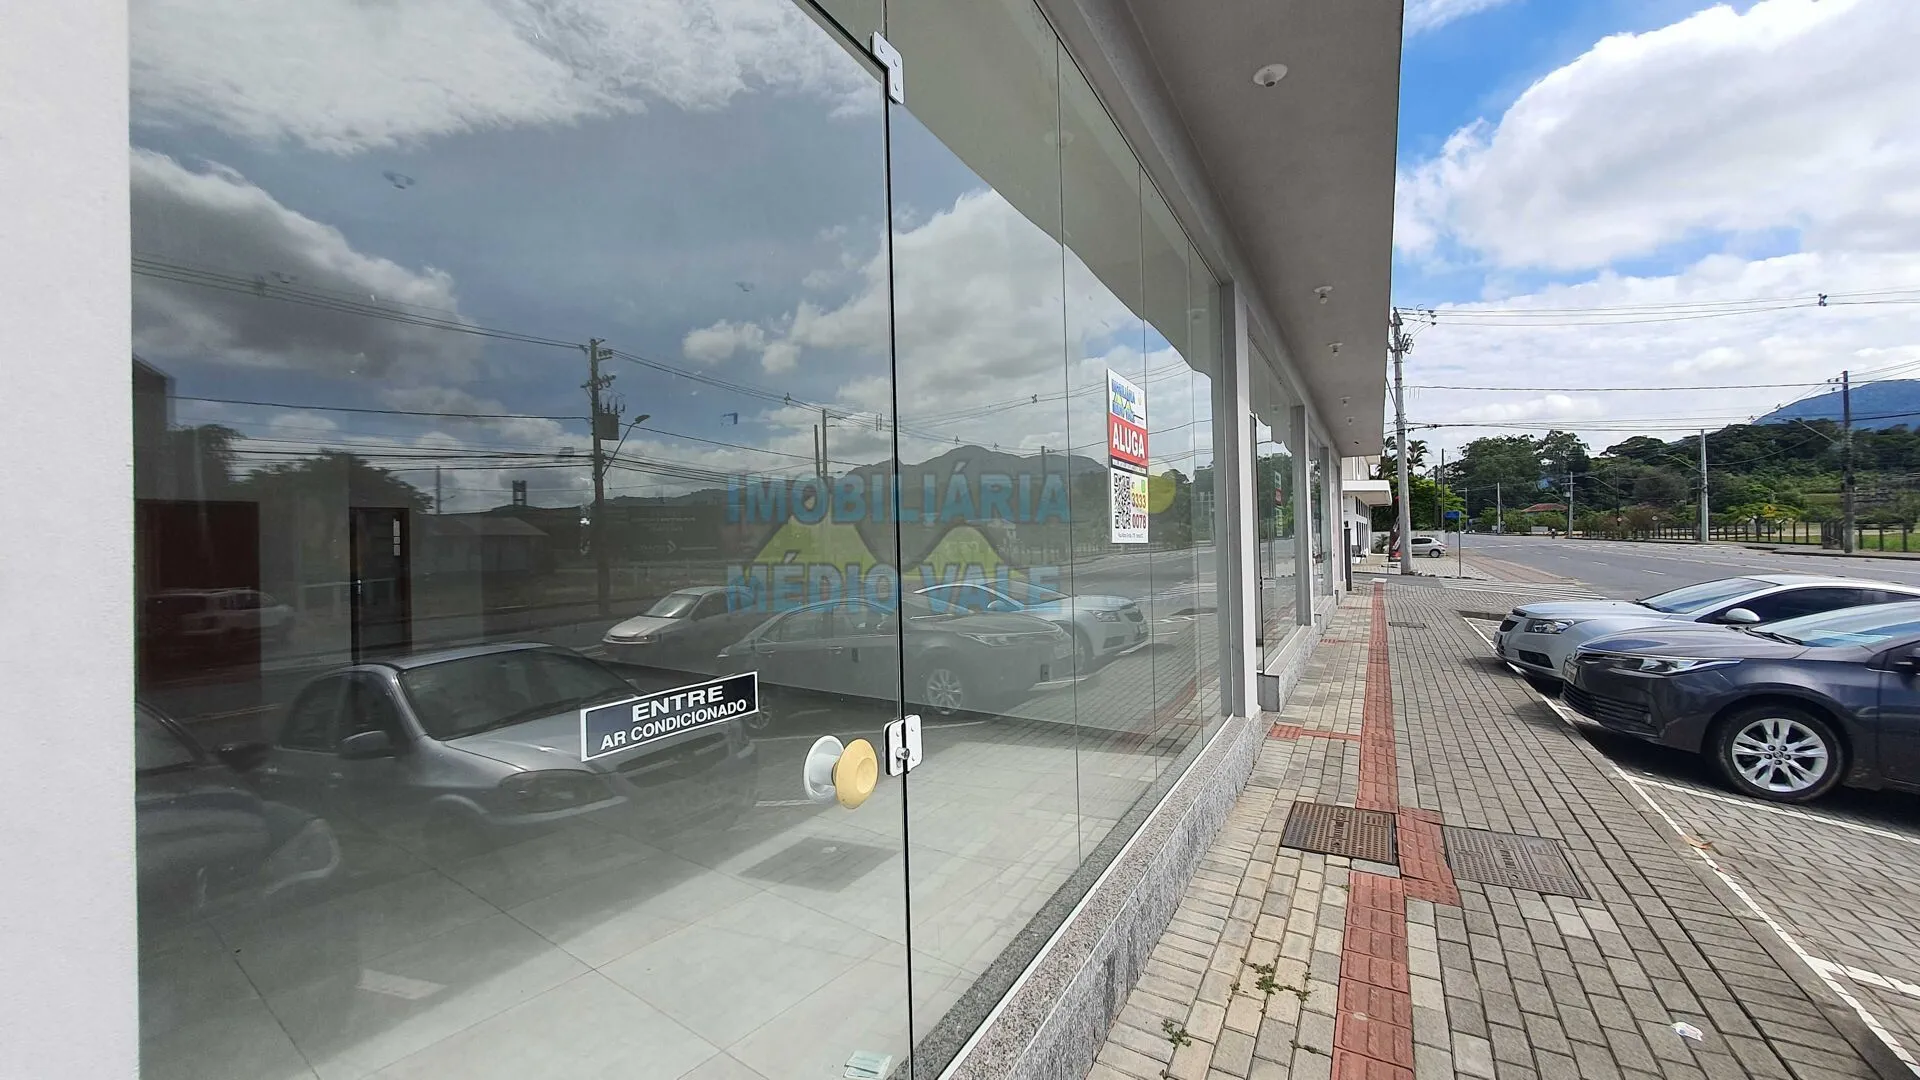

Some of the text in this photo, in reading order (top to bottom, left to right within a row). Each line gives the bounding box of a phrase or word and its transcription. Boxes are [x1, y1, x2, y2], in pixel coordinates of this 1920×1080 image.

[1112, 422, 1145, 459] ALUGA
[1131, 492, 1147, 509] 3333
[1132, 514, 1147, 530] 0078
[632, 685, 724, 722] ENTRE
[600, 699, 747, 751] AR CONDICIONADO
